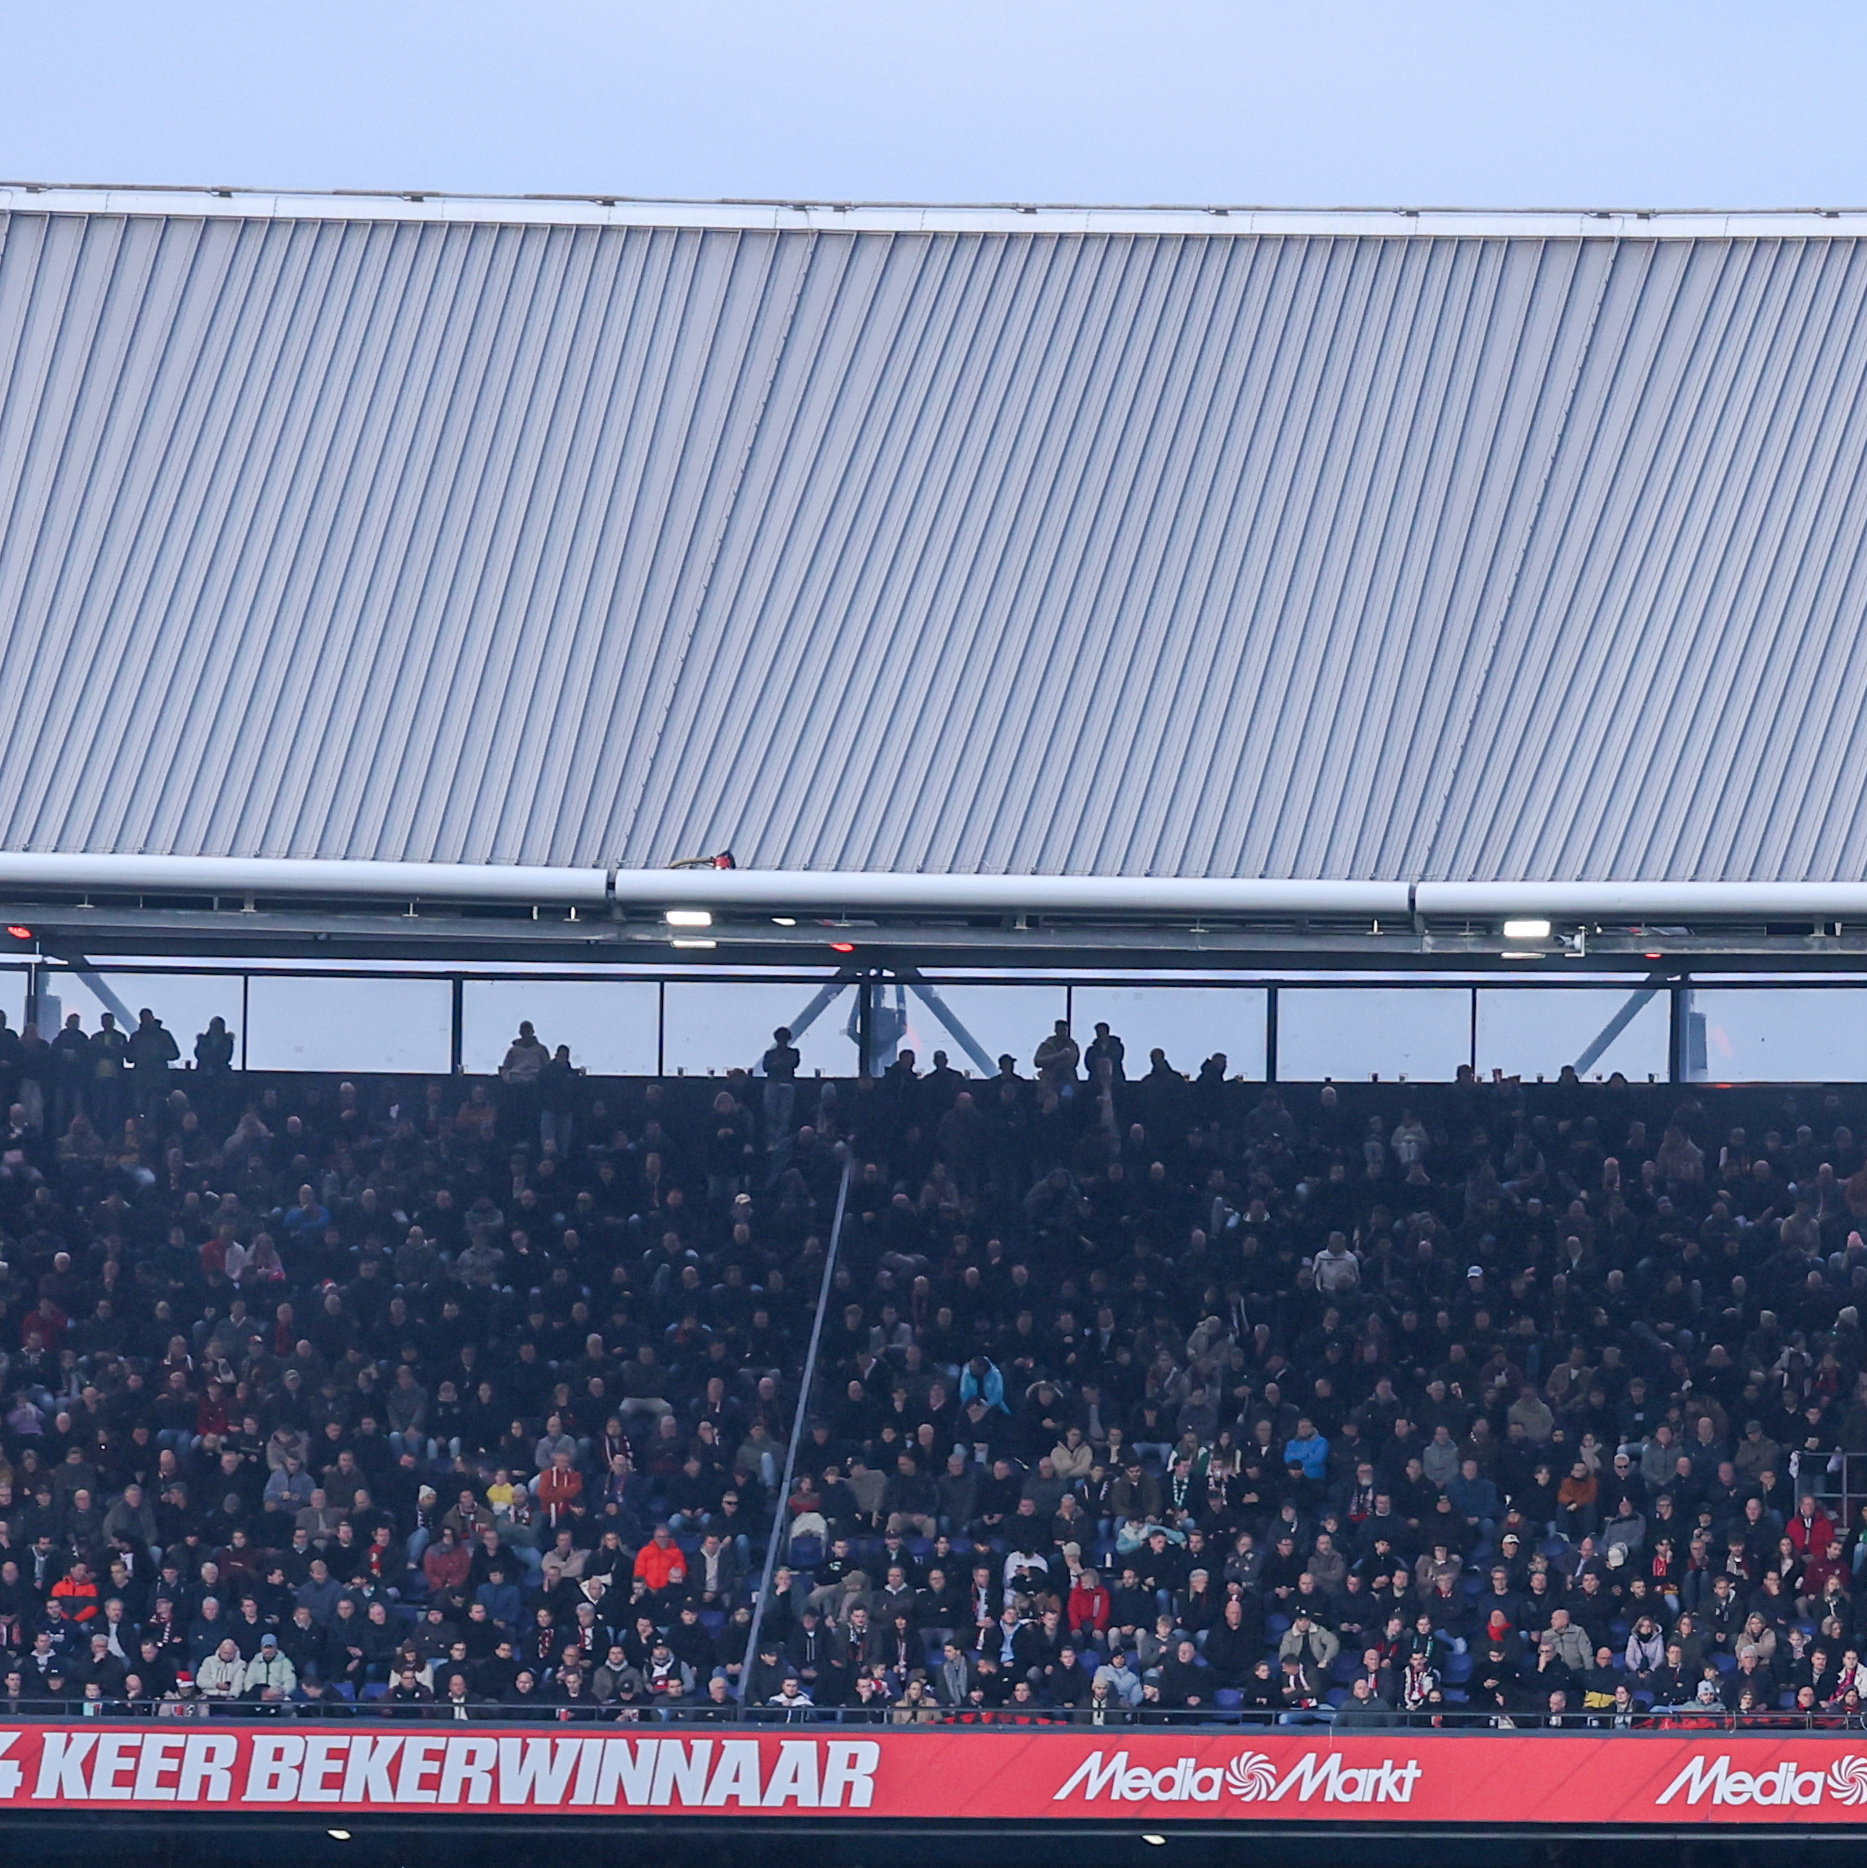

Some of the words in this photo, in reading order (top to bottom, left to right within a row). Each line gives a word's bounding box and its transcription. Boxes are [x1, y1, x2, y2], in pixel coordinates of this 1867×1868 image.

[31, 1732, 238, 1802] KEER
[241, 1734, 880, 1808] BEKERWINNAAR
[1053, 1751, 1225, 1801] Media
[1267, 1752, 1423, 1803] Markt
[1655, 1755, 1826, 1806] Media
